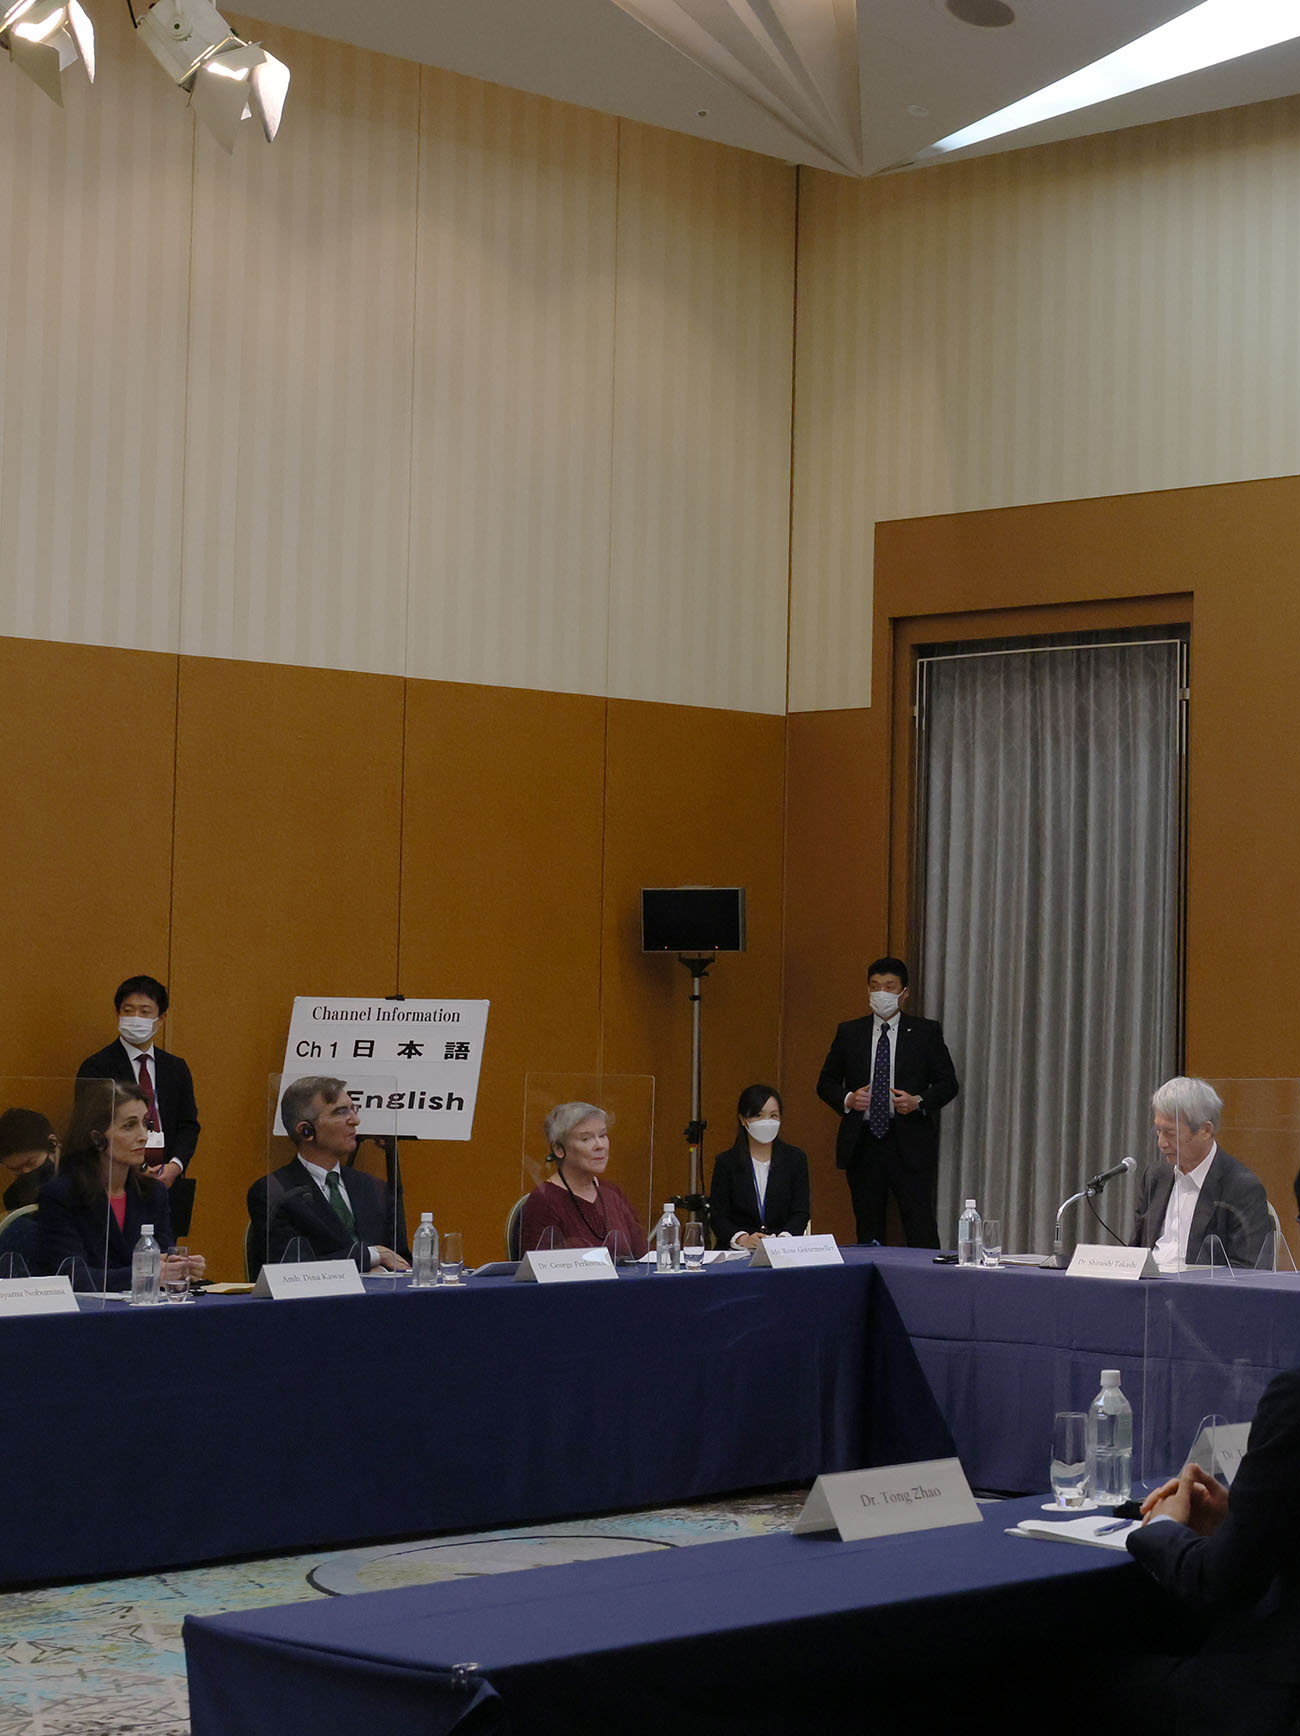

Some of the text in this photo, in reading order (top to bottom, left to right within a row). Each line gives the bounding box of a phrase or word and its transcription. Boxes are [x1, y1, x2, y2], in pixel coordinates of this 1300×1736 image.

[312, 1006, 461, 1023] Channel Information
[296, 1041, 322, 1058] Ch
[330, 1042, 338, 1058] 1
[860, 1486, 942, 1507] Dr. Tong Zhao
